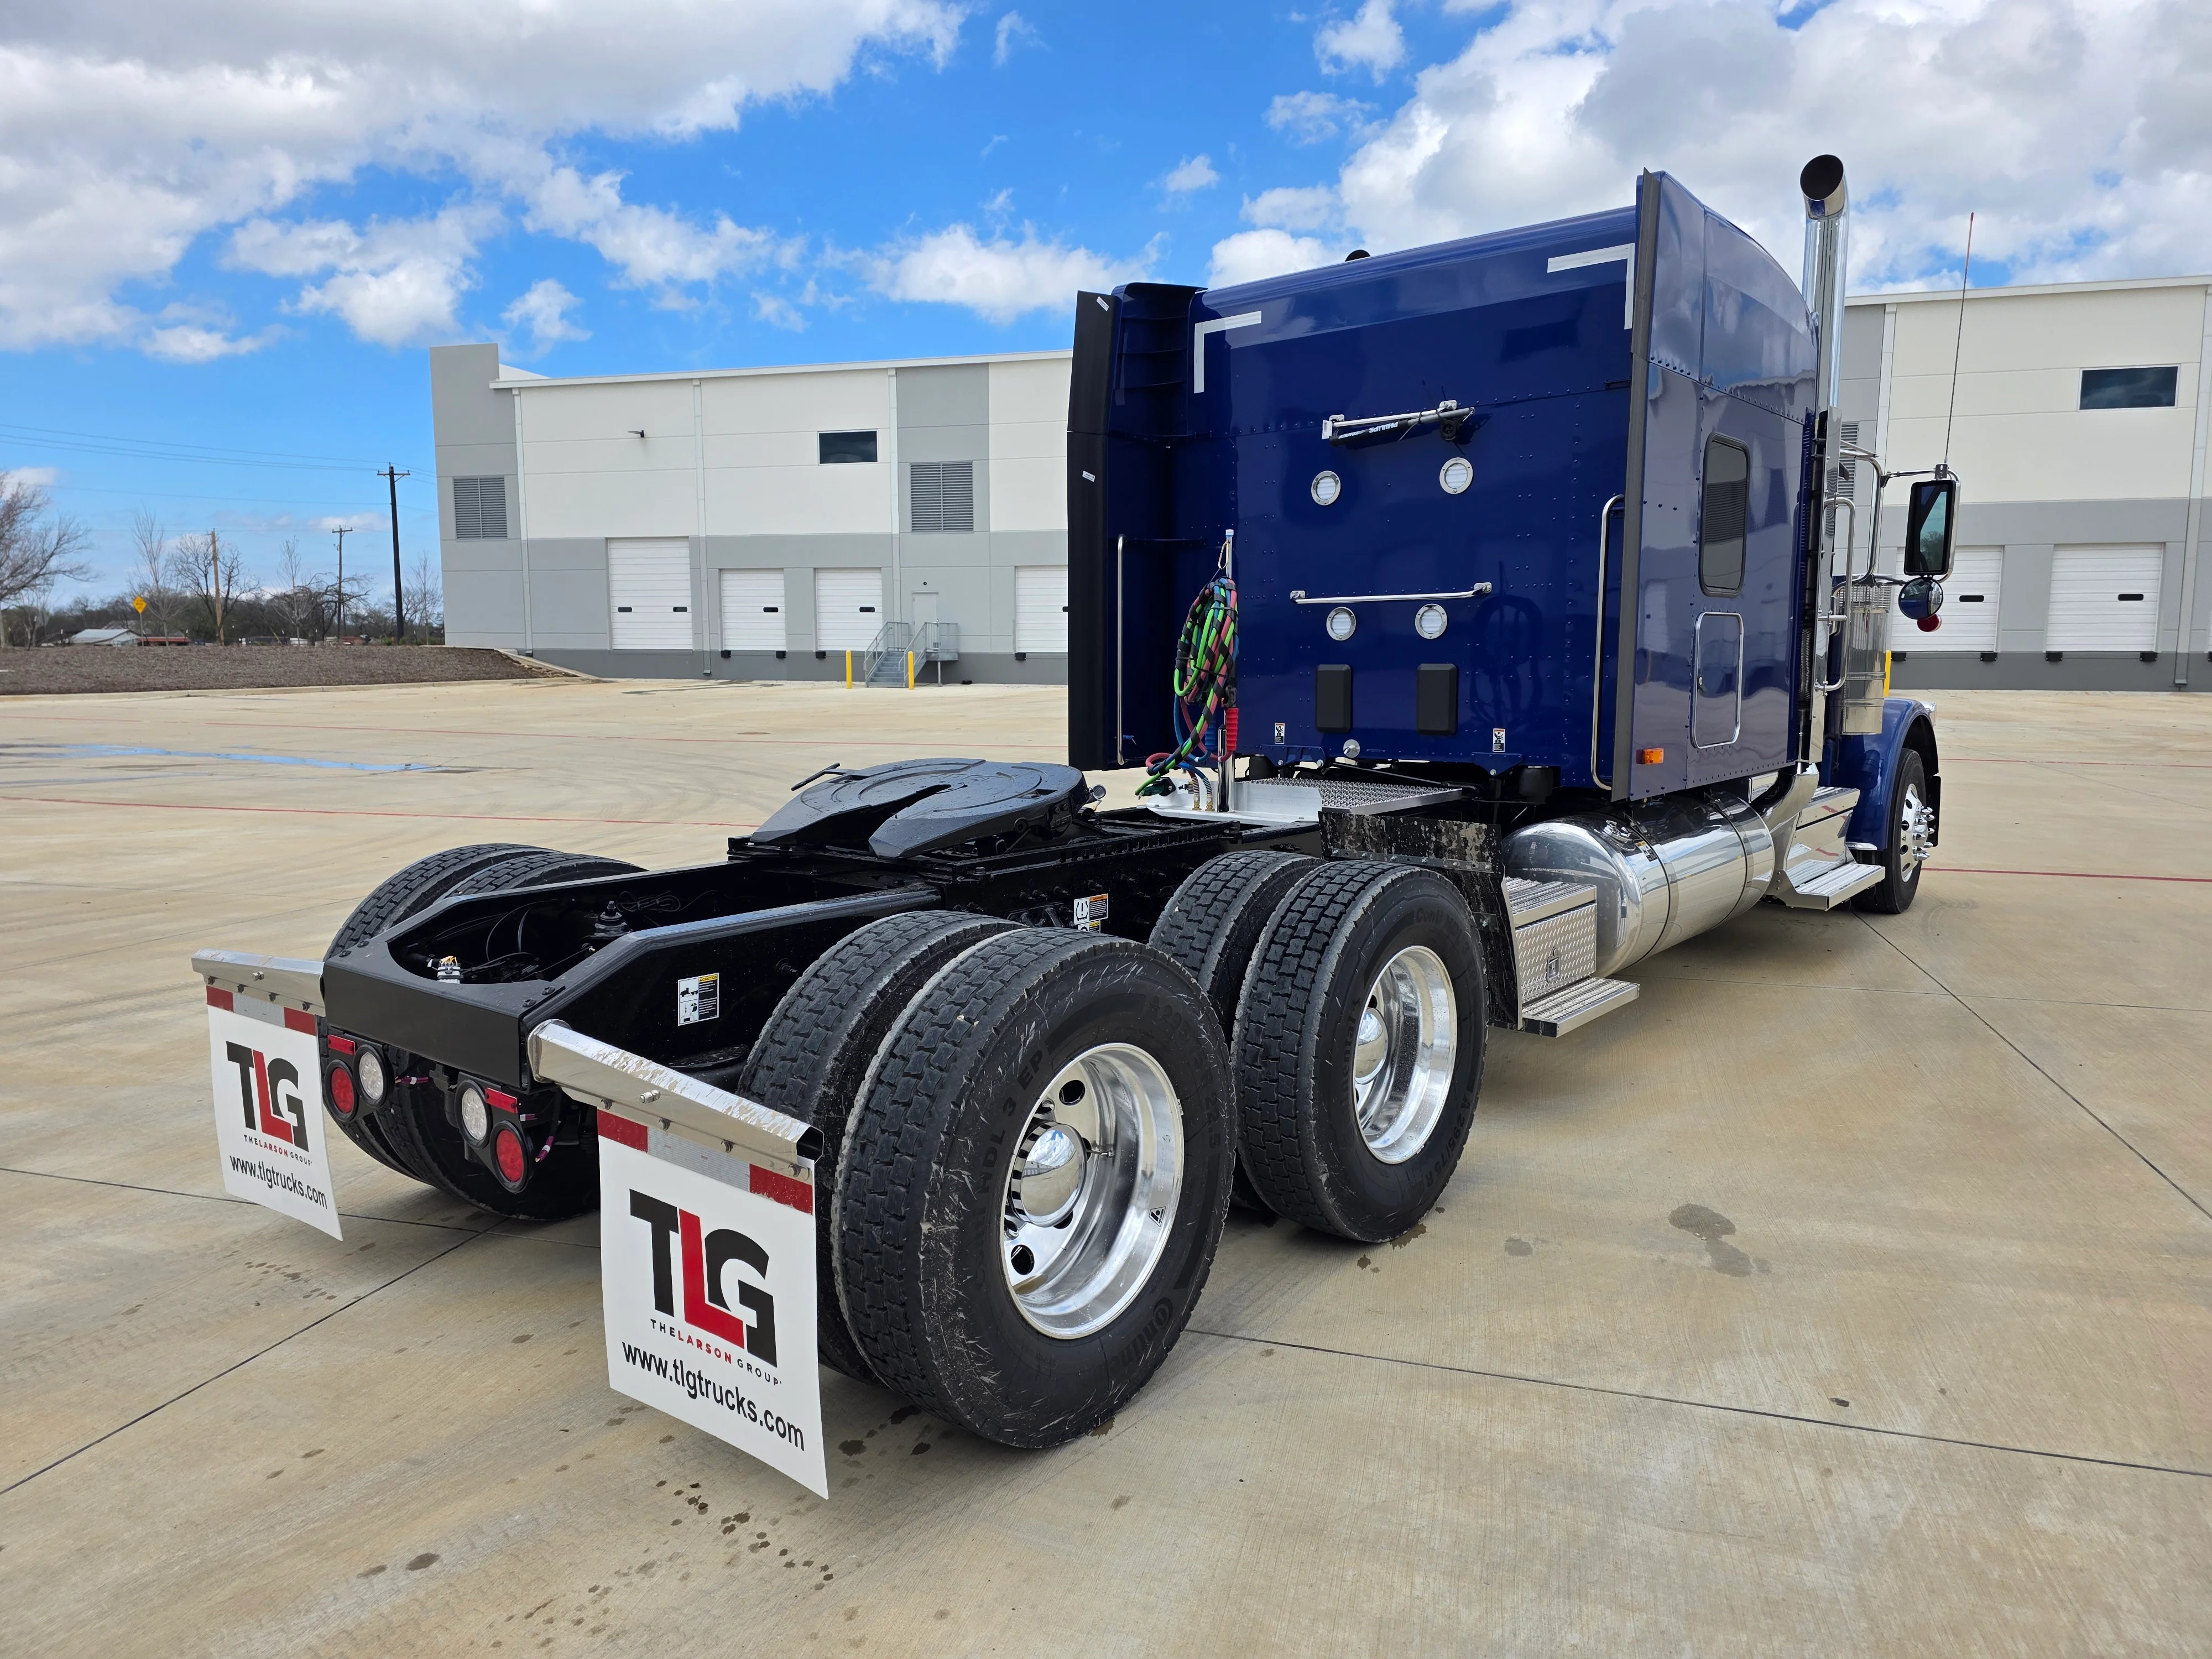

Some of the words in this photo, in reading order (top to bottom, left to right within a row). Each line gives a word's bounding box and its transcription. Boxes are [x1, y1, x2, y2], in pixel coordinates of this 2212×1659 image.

[226, 1041, 309, 1152] TLG
[1003, 1097, 1017, 1117] 3
[1017, 1050, 1044, 1093] EP
[229, 1155, 327, 1209] www.tlgtrucks.com
[290, 1151, 312, 1167] GROUP
[629, 1188, 778, 1368] TLG
[622, 1341, 805, 1452] www.tlgtrucks.com
[737, 1358, 779, 1386] GROUP
